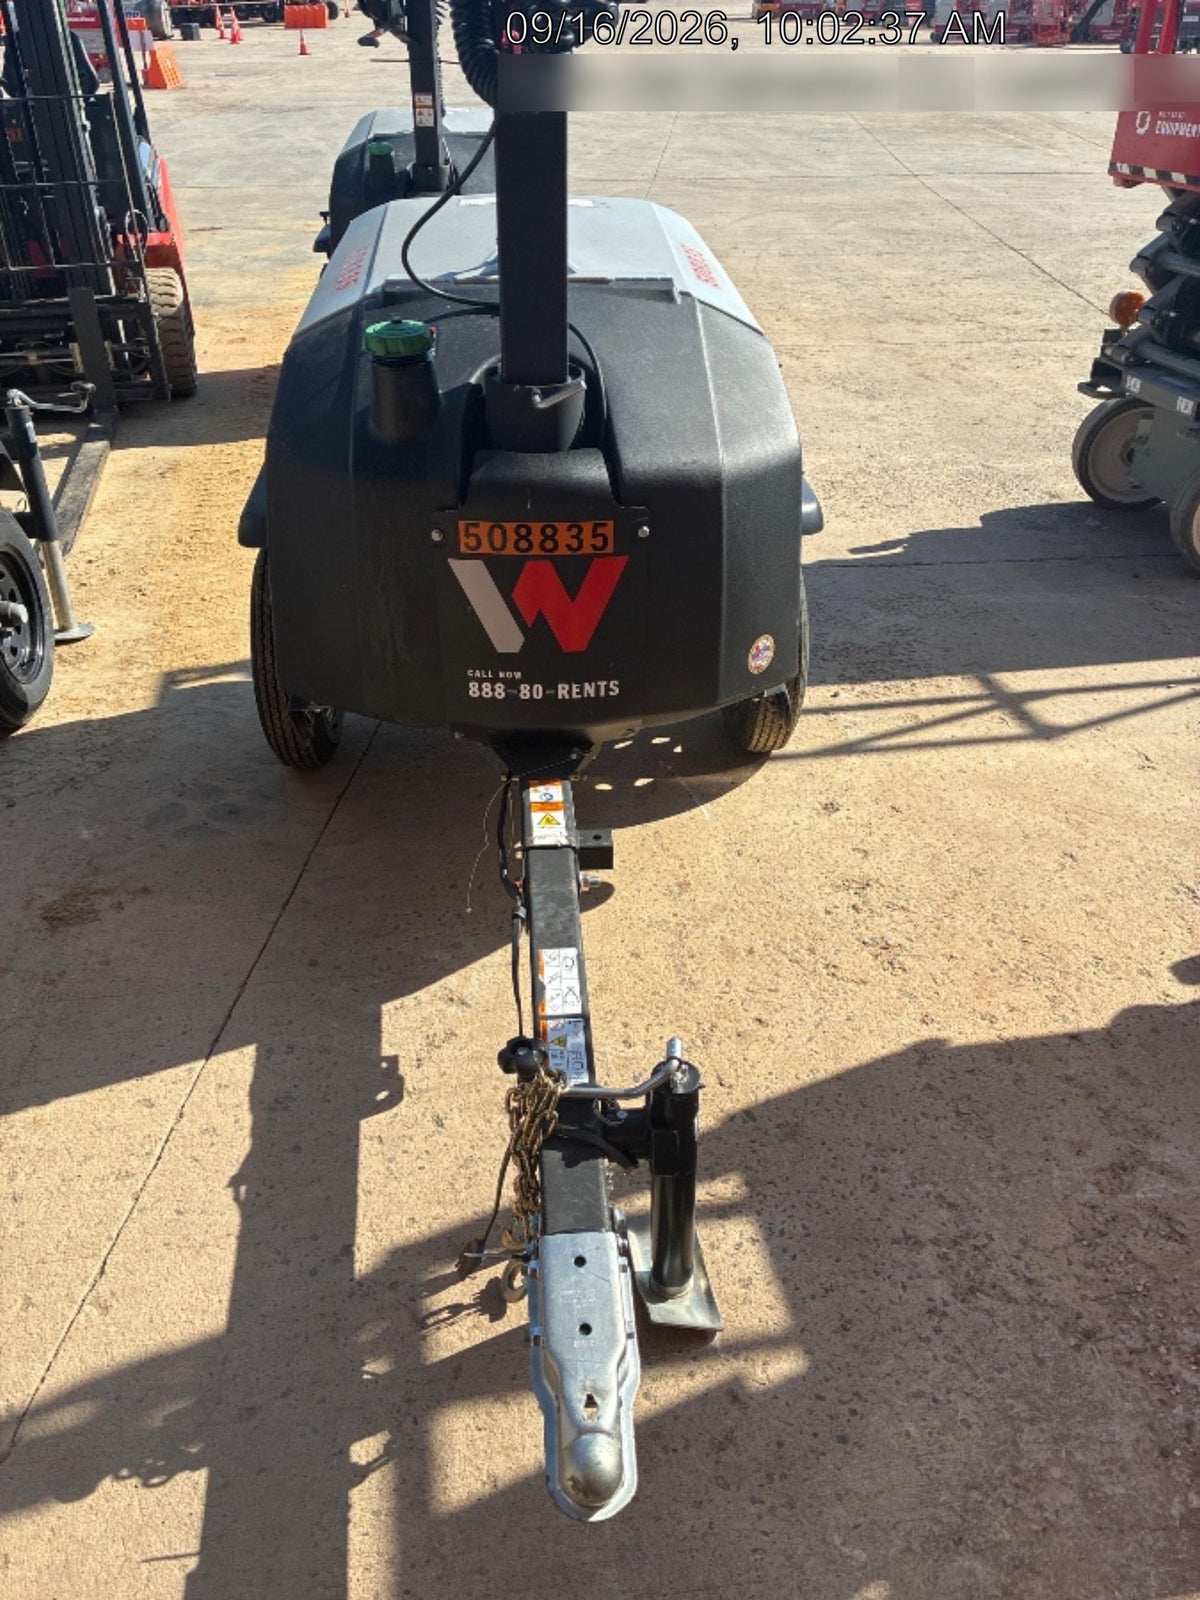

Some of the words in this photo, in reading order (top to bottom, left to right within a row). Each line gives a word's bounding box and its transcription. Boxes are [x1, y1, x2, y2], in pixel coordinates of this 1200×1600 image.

[463, 523, 609, 553] 508835
[467, 669, 494, 679] CALL
[499, 671, 522, 680] NOW
